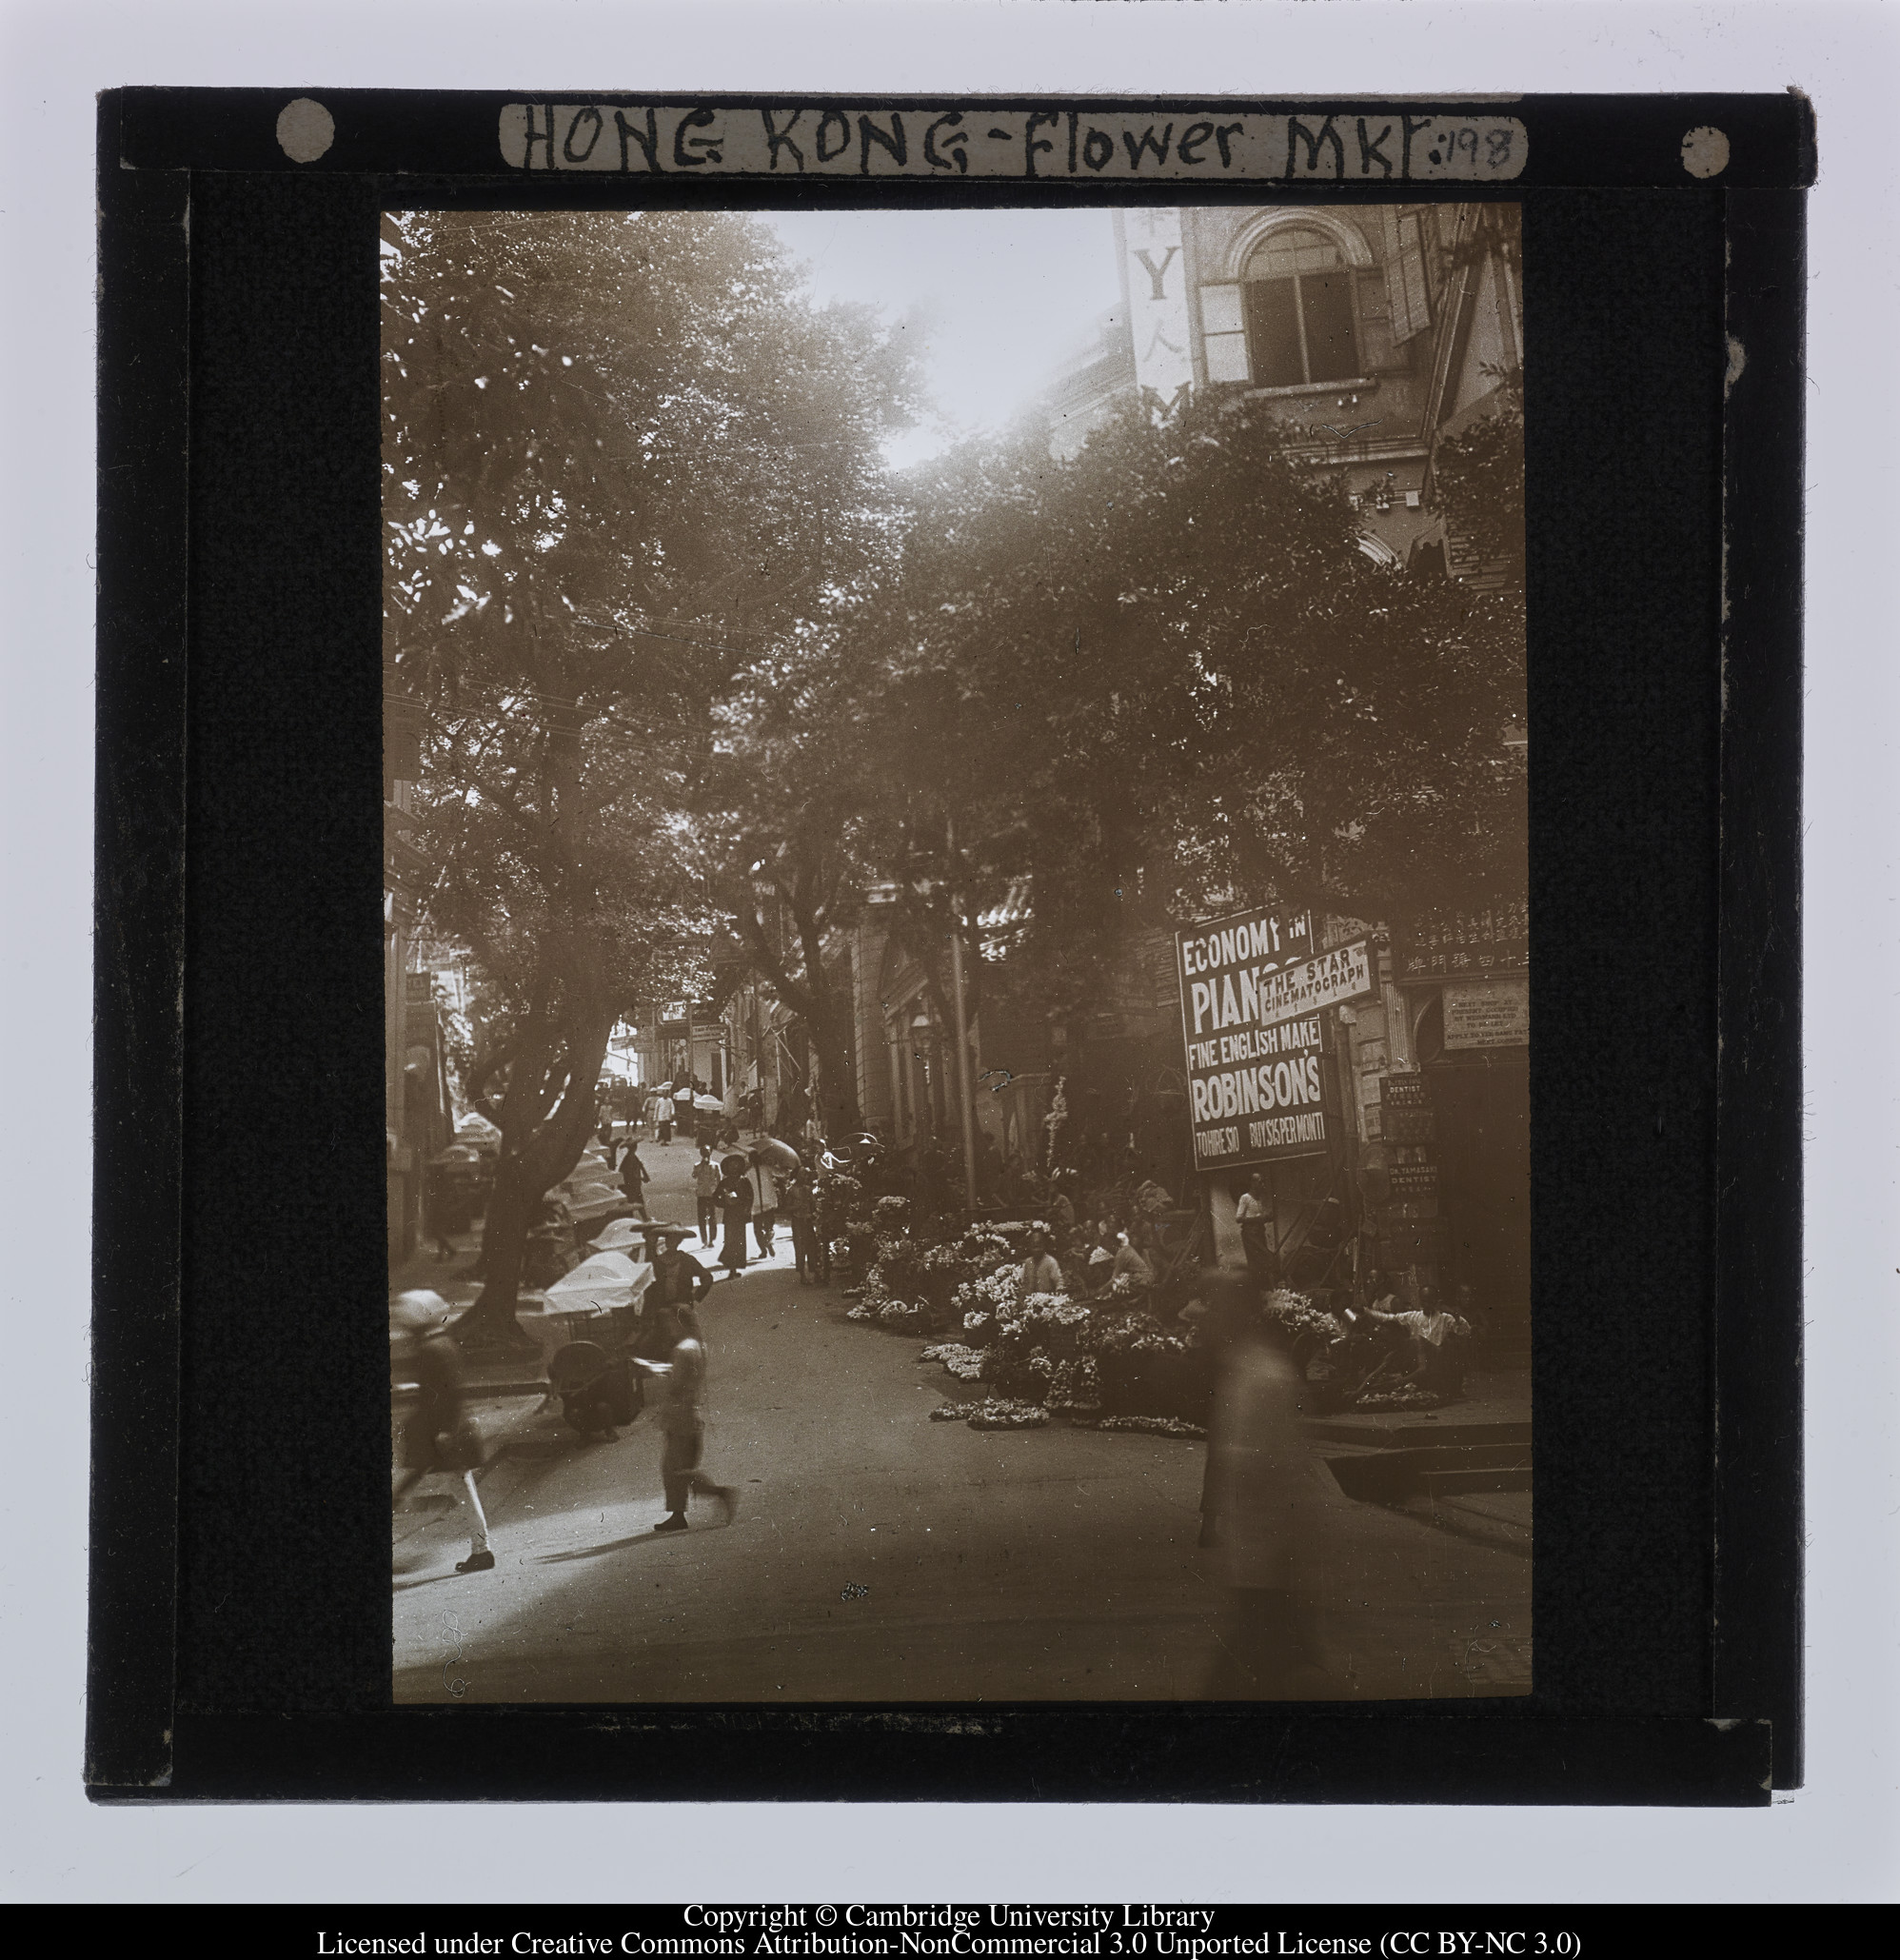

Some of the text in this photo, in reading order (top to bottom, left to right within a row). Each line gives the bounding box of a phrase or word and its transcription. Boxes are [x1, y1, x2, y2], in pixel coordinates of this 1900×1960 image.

[523, 104, 723, 172] HONG
[762, 109, 969, 174] KONG
[1182, 916, 1281, 976] ECONOMY
[1191, 957, 1302, 1036] PIAN
[1264, 948, 1352, 998] THE STAR
[1265, 963, 1364, 1013] CINEMATOGRAPH
[1189, 1020, 1320, 1071] FINE ENGLISH MAKE
[1192, 1048, 1321, 1123] ROBINSON'S
[1390, 1085, 1421, 1094] DENTIST
[1279, 1115, 1297, 1145] PER
[1391, 1176, 1437, 1184] DENTIST
